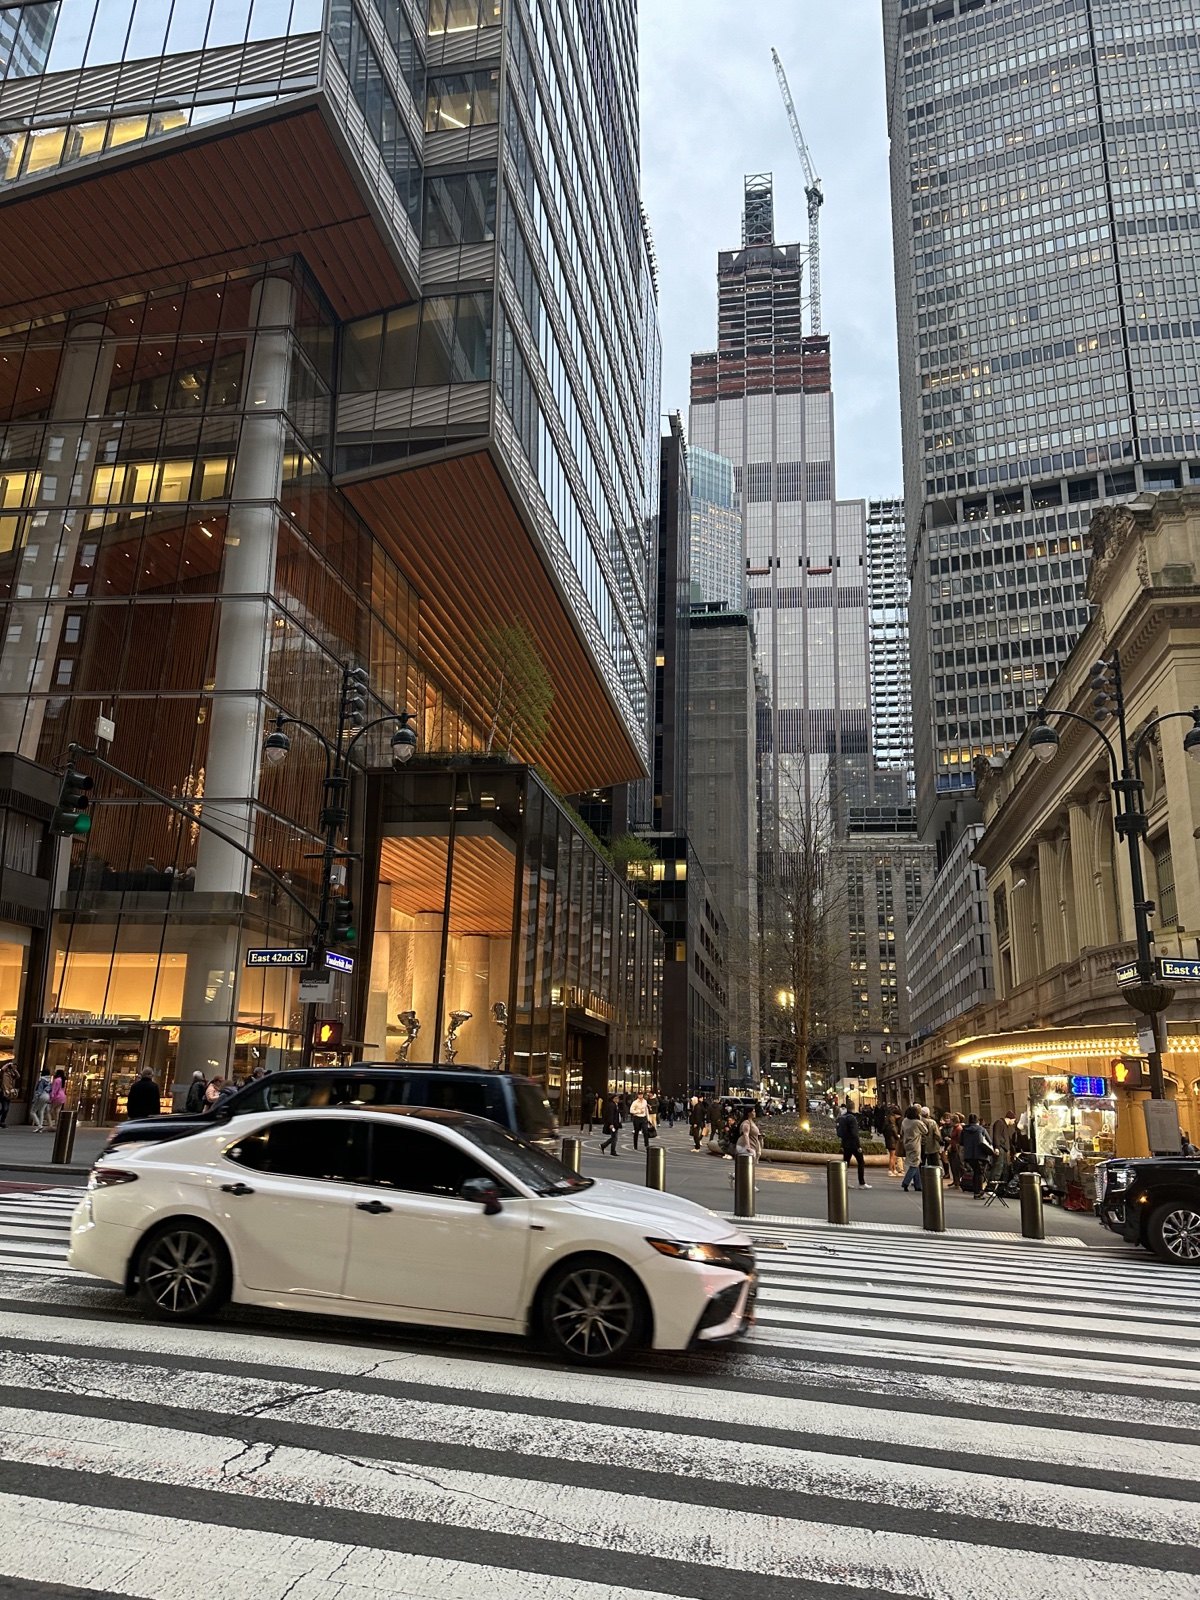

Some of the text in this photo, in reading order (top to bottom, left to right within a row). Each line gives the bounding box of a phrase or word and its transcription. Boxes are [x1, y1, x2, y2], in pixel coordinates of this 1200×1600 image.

[251, 953, 304, 962] East 42nd St
[1165, 964, 1190, 975] East
